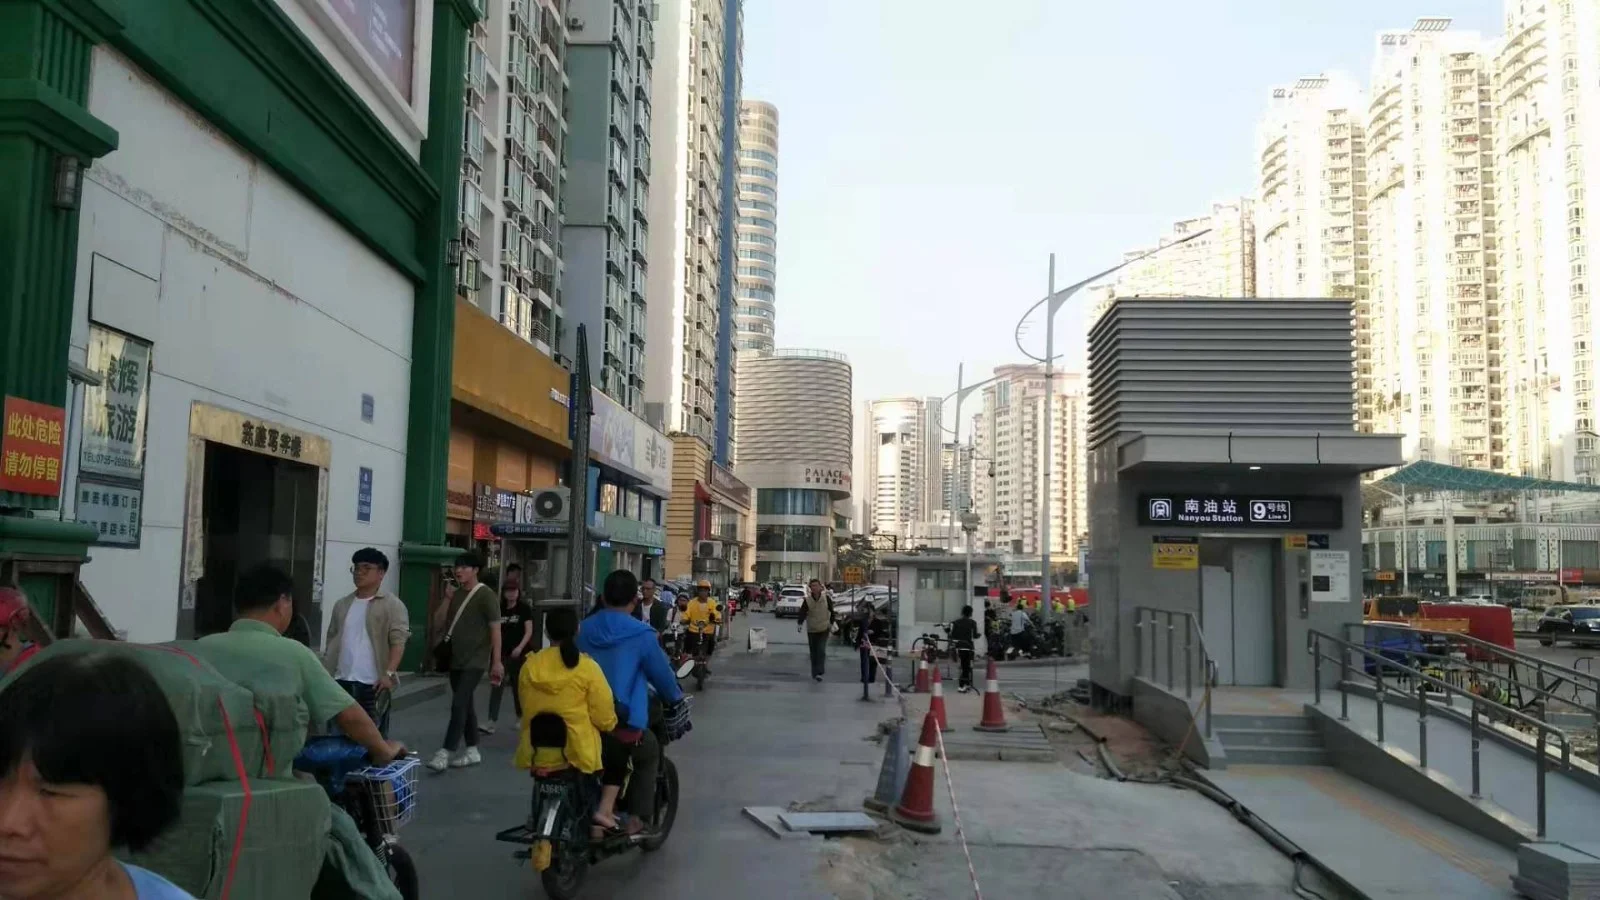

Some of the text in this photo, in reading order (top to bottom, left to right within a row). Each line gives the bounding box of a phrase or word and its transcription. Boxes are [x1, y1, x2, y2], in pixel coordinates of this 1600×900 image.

[7, 411, 62, 445] 此处危险
[4, 450, 60, 481] 请勿停留
[1184, 499, 1237, 513] 南油站
[1253, 503, 1266, 519] 9
[1267, 503, 1287, 513] 号线
[1178, 513, 1244, 523] Nanyou Station
